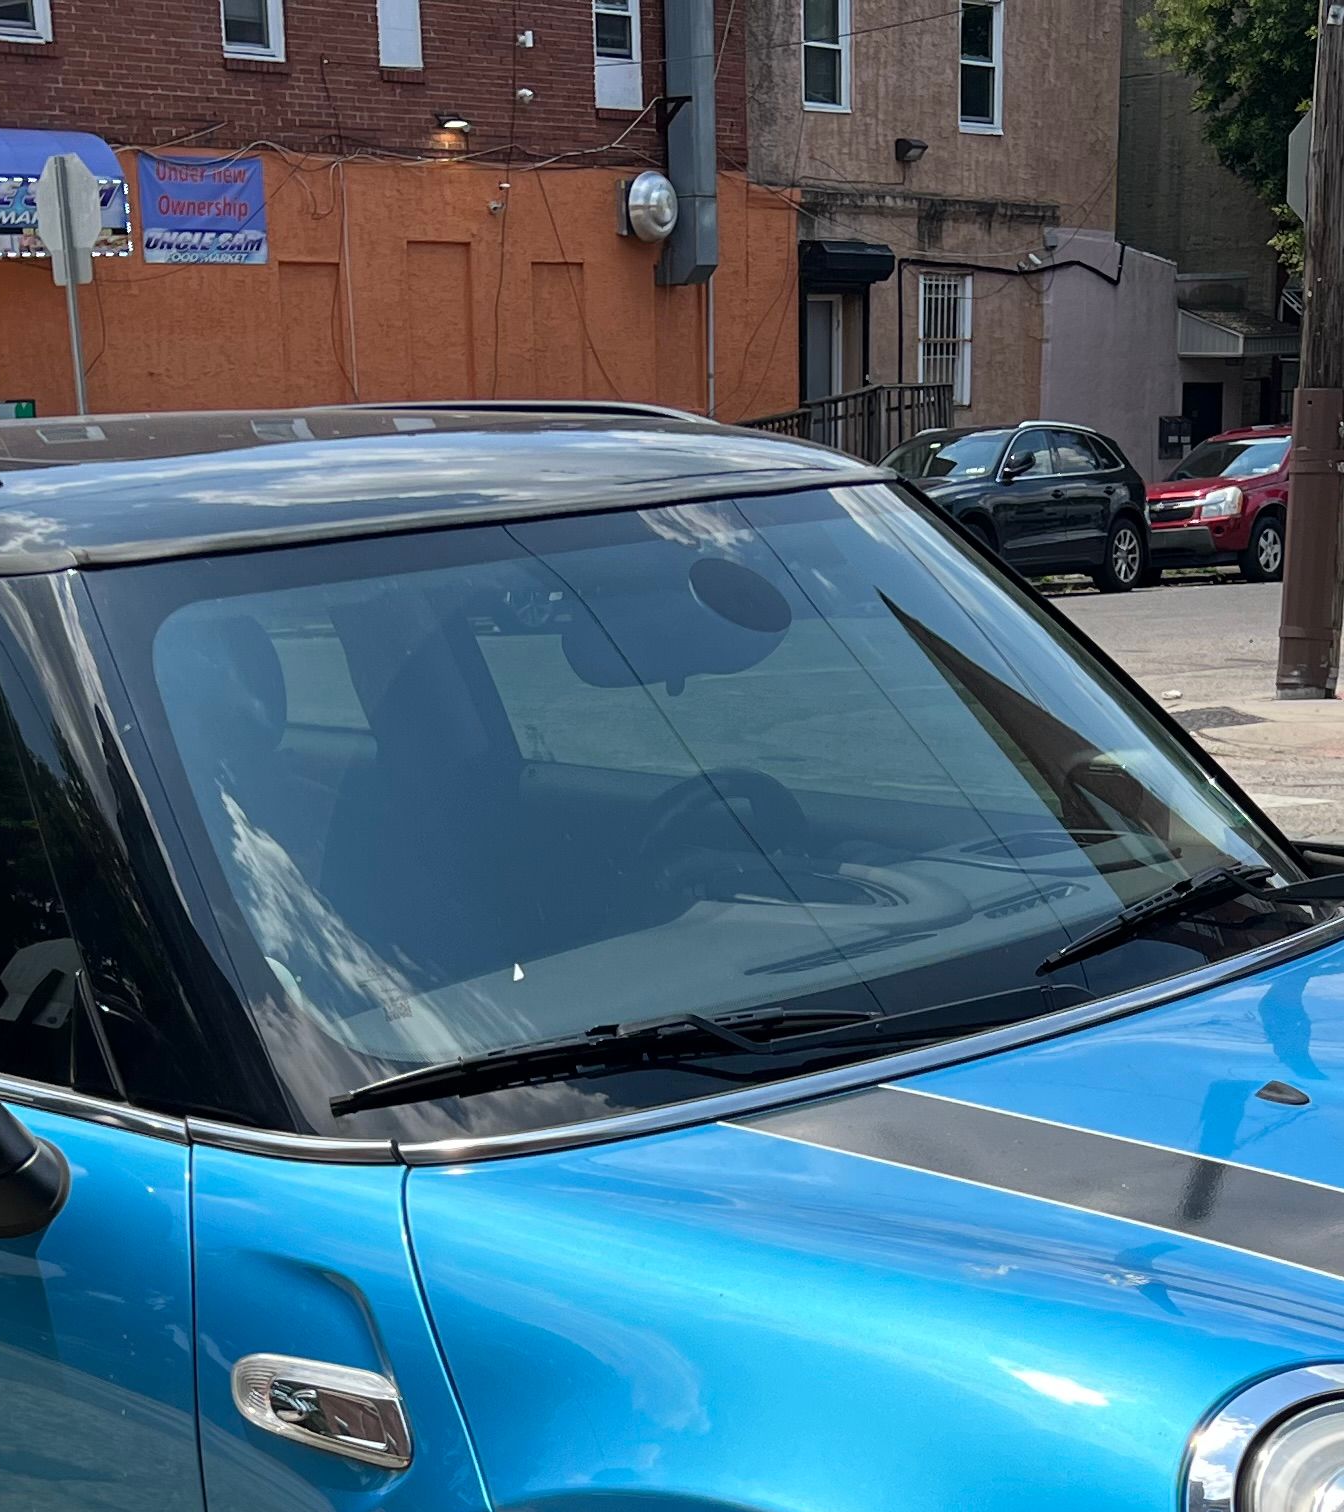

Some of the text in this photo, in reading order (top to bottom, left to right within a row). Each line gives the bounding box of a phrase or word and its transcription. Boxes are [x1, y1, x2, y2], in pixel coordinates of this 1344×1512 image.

[156, 160, 247, 184] Under new
[158, 194, 248, 221] Ownership
